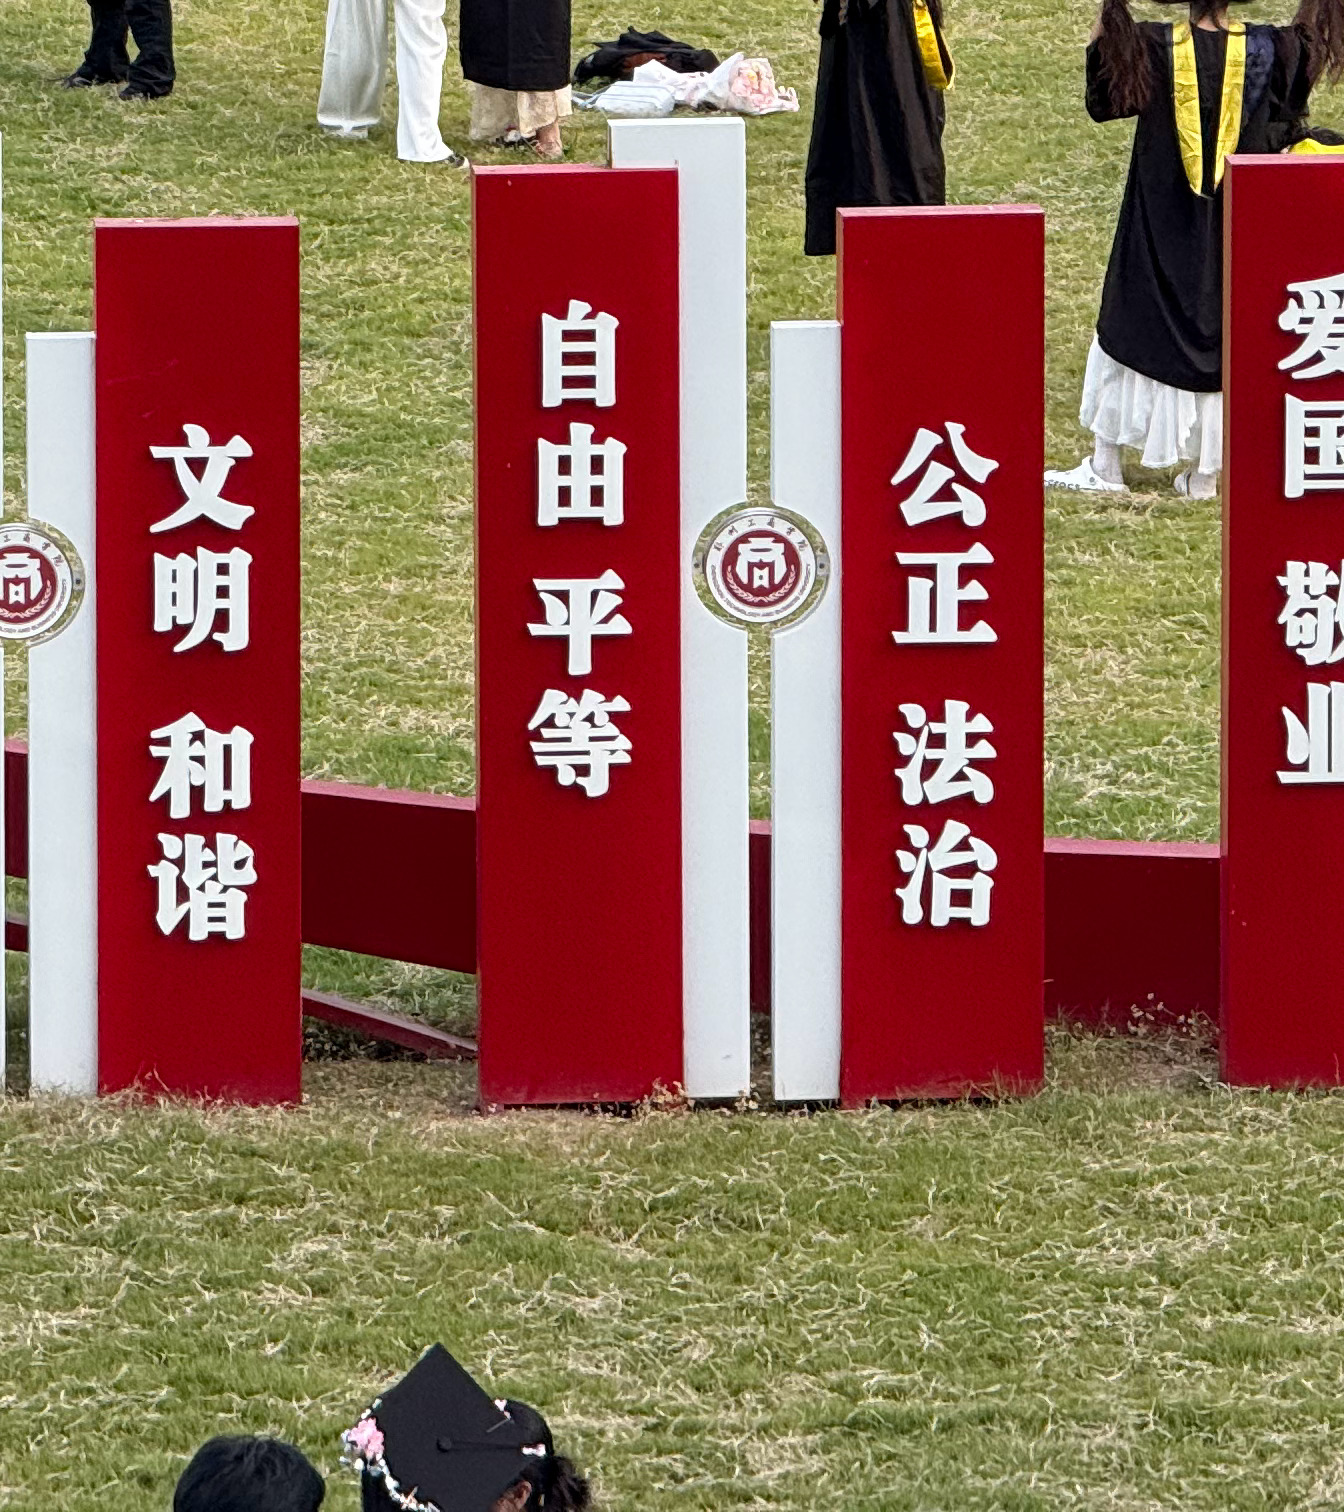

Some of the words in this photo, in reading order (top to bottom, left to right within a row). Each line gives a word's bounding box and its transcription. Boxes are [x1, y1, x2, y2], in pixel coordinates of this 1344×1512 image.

[537, 299, 628, 527] 自由
[149, 423, 256, 653] 文明
[890, 421, 1000, 644] 公正
[526, 568, 633, 798] 平等
[146, 711, 258, 941] 和谐
[892, 699, 998, 927] 法治
